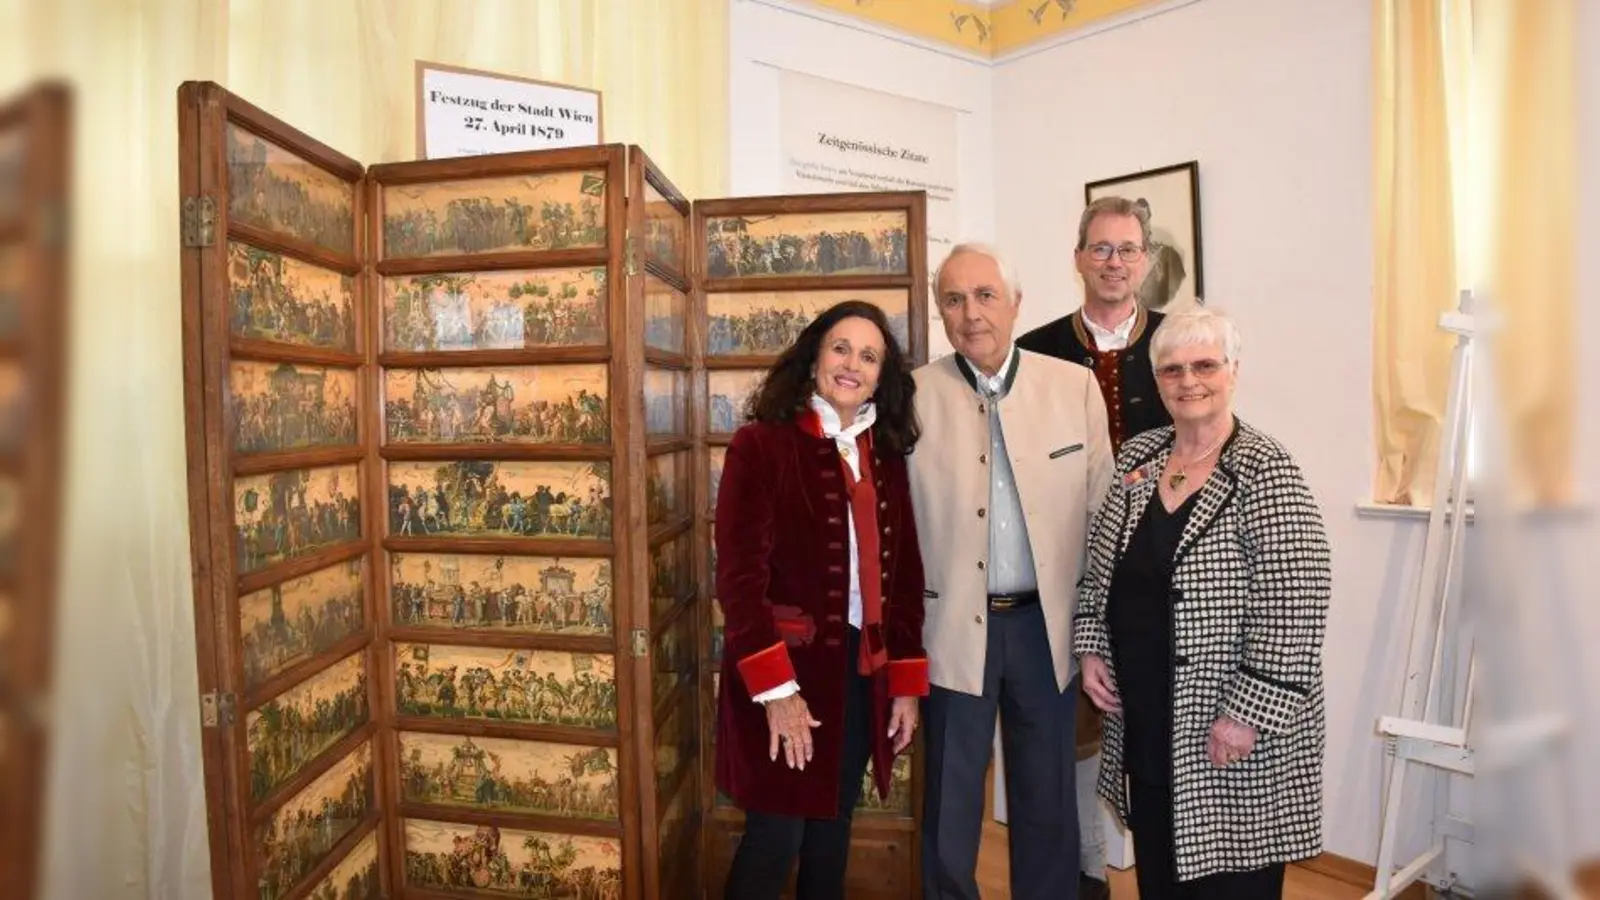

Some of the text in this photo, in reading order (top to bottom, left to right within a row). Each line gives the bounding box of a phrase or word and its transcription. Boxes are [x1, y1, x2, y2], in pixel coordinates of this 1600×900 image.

[430, 90, 594, 123] Festzug der Stadt Wien
[464, 116, 565, 140] 27. April 1879
[817, 132, 929, 164] Zeitgenössische Zitate
